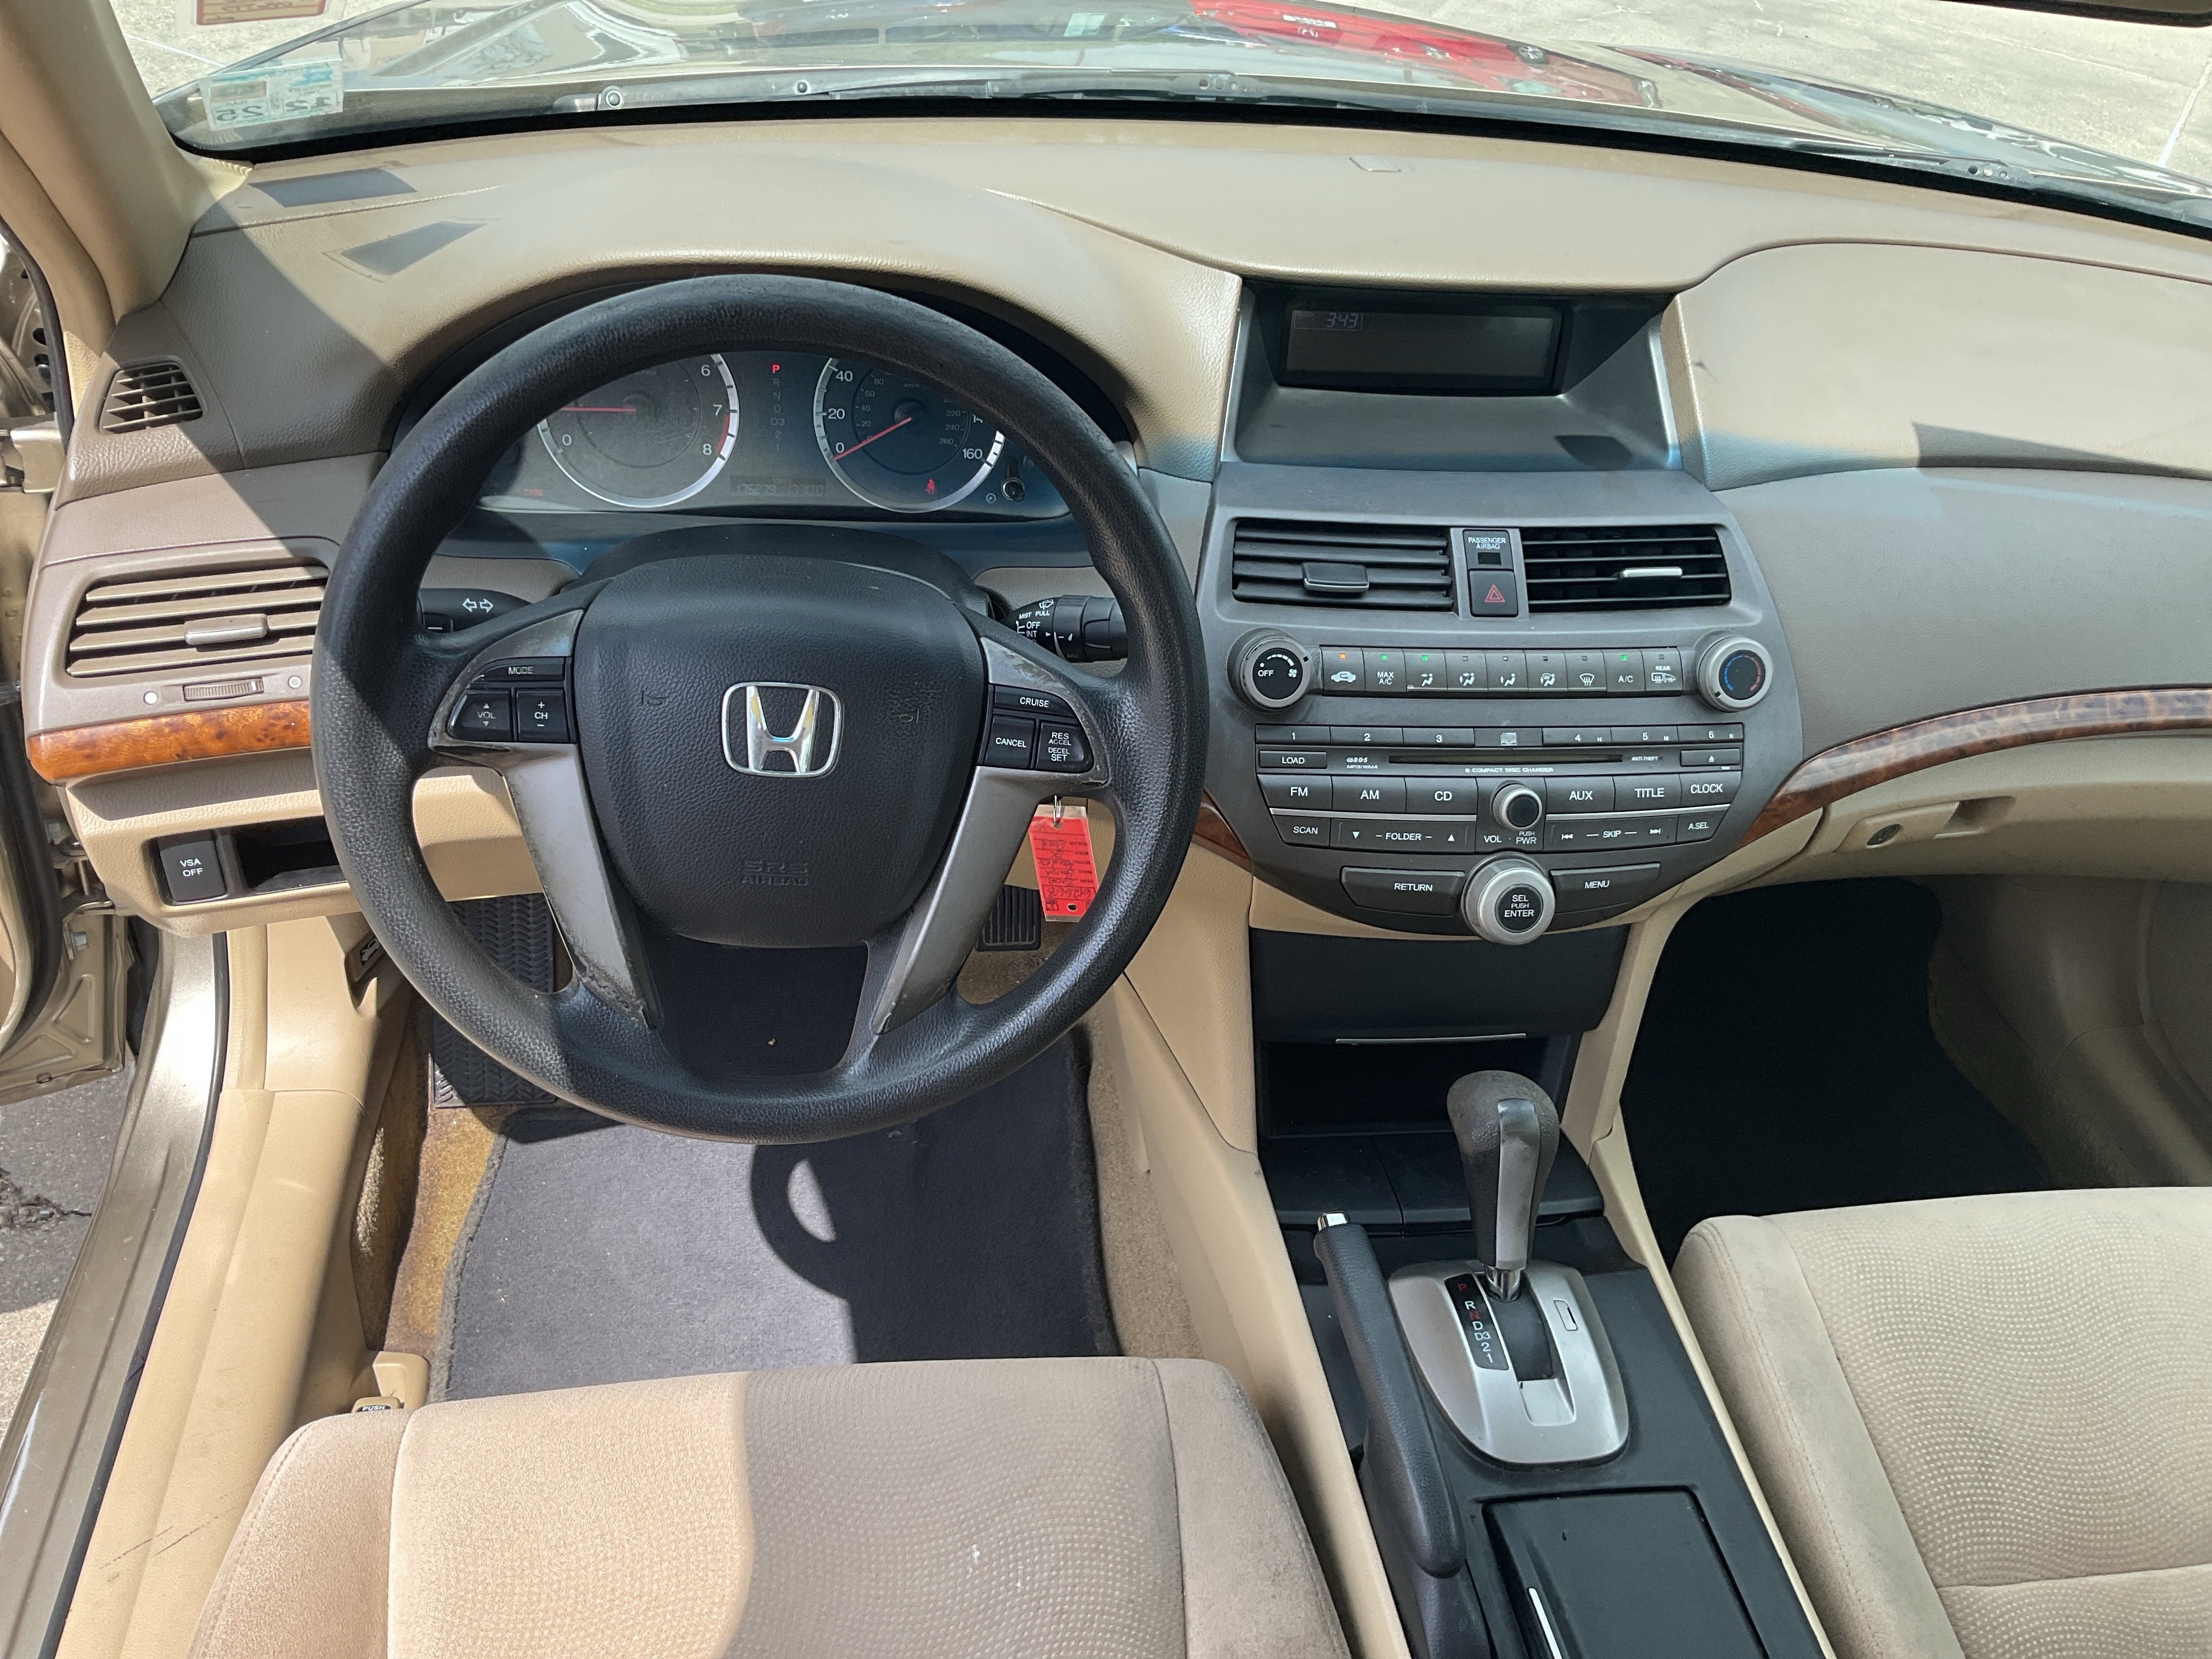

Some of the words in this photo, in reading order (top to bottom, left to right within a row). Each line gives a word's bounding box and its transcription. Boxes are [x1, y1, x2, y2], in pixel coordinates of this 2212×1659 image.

[701, 364, 710, 377] 6
[772, 364, 780, 374] P
[836, 370, 853, 382] 40
[713, 404, 723, 416] 7
[828, 408, 845, 420] 20
[771, 418, 785, 426] D3
[562, 435, 572, 446] 0
[702, 444, 712, 456] 8
[836, 442, 844, 453] 0
[963, 448, 983, 460] 160
[1026, 621, 1041, 629] OFF
[1618, 675, 1633, 683] A/C
[1020, 697, 1049, 708] CRUISE
[1364, 733, 1370, 741] 2
[1436, 735, 1442, 743] 3
[1643, 732, 1648, 741] 5
[1708, 731, 1714, 739] 6
[995, 737, 1026, 748] CANCEL
[1282, 757, 1305, 765] LOAD
[1290, 787, 1308, 797] FM
[1635, 788, 1664, 798] TITLE
[1690, 783, 1723, 794] CLOCK
[1360, 790, 1379, 800] AM
[1434, 791, 1452, 801] CD
[1569, 791, 1593, 800] AUX
[1293, 826, 1318, 834] SCAN
[1688, 822, 1709, 830] A.SEL
[1385, 832, 1421, 841] FOLDER
[1603, 830, 1621, 838] SKIP
[1483, 835, 1502, 843] VOL
[1516, 836, 1537, 844] PWR
[179, 858, 201, 867] VSA
[182, 867, 203, 877] OFF
[1394, 883, 1433, 891] RETURN
[1584, 880, 1610, 889] MENU
[1512, 894, 1528, 902] SEL
[1504, 909, 1534, 917] ENTER
[1458, 1283, 1467, 1291] P
[1464, 1301, 1476, 1310] R
[1469, 1311, 1480, 1320] N
[1472, 1321, 1483, 1330] D
[1474, 1331, 1491, 1340] D3
[1481, 1342, 1491, 1352] 2
[1487, 1353, 1493, 1363] 1
